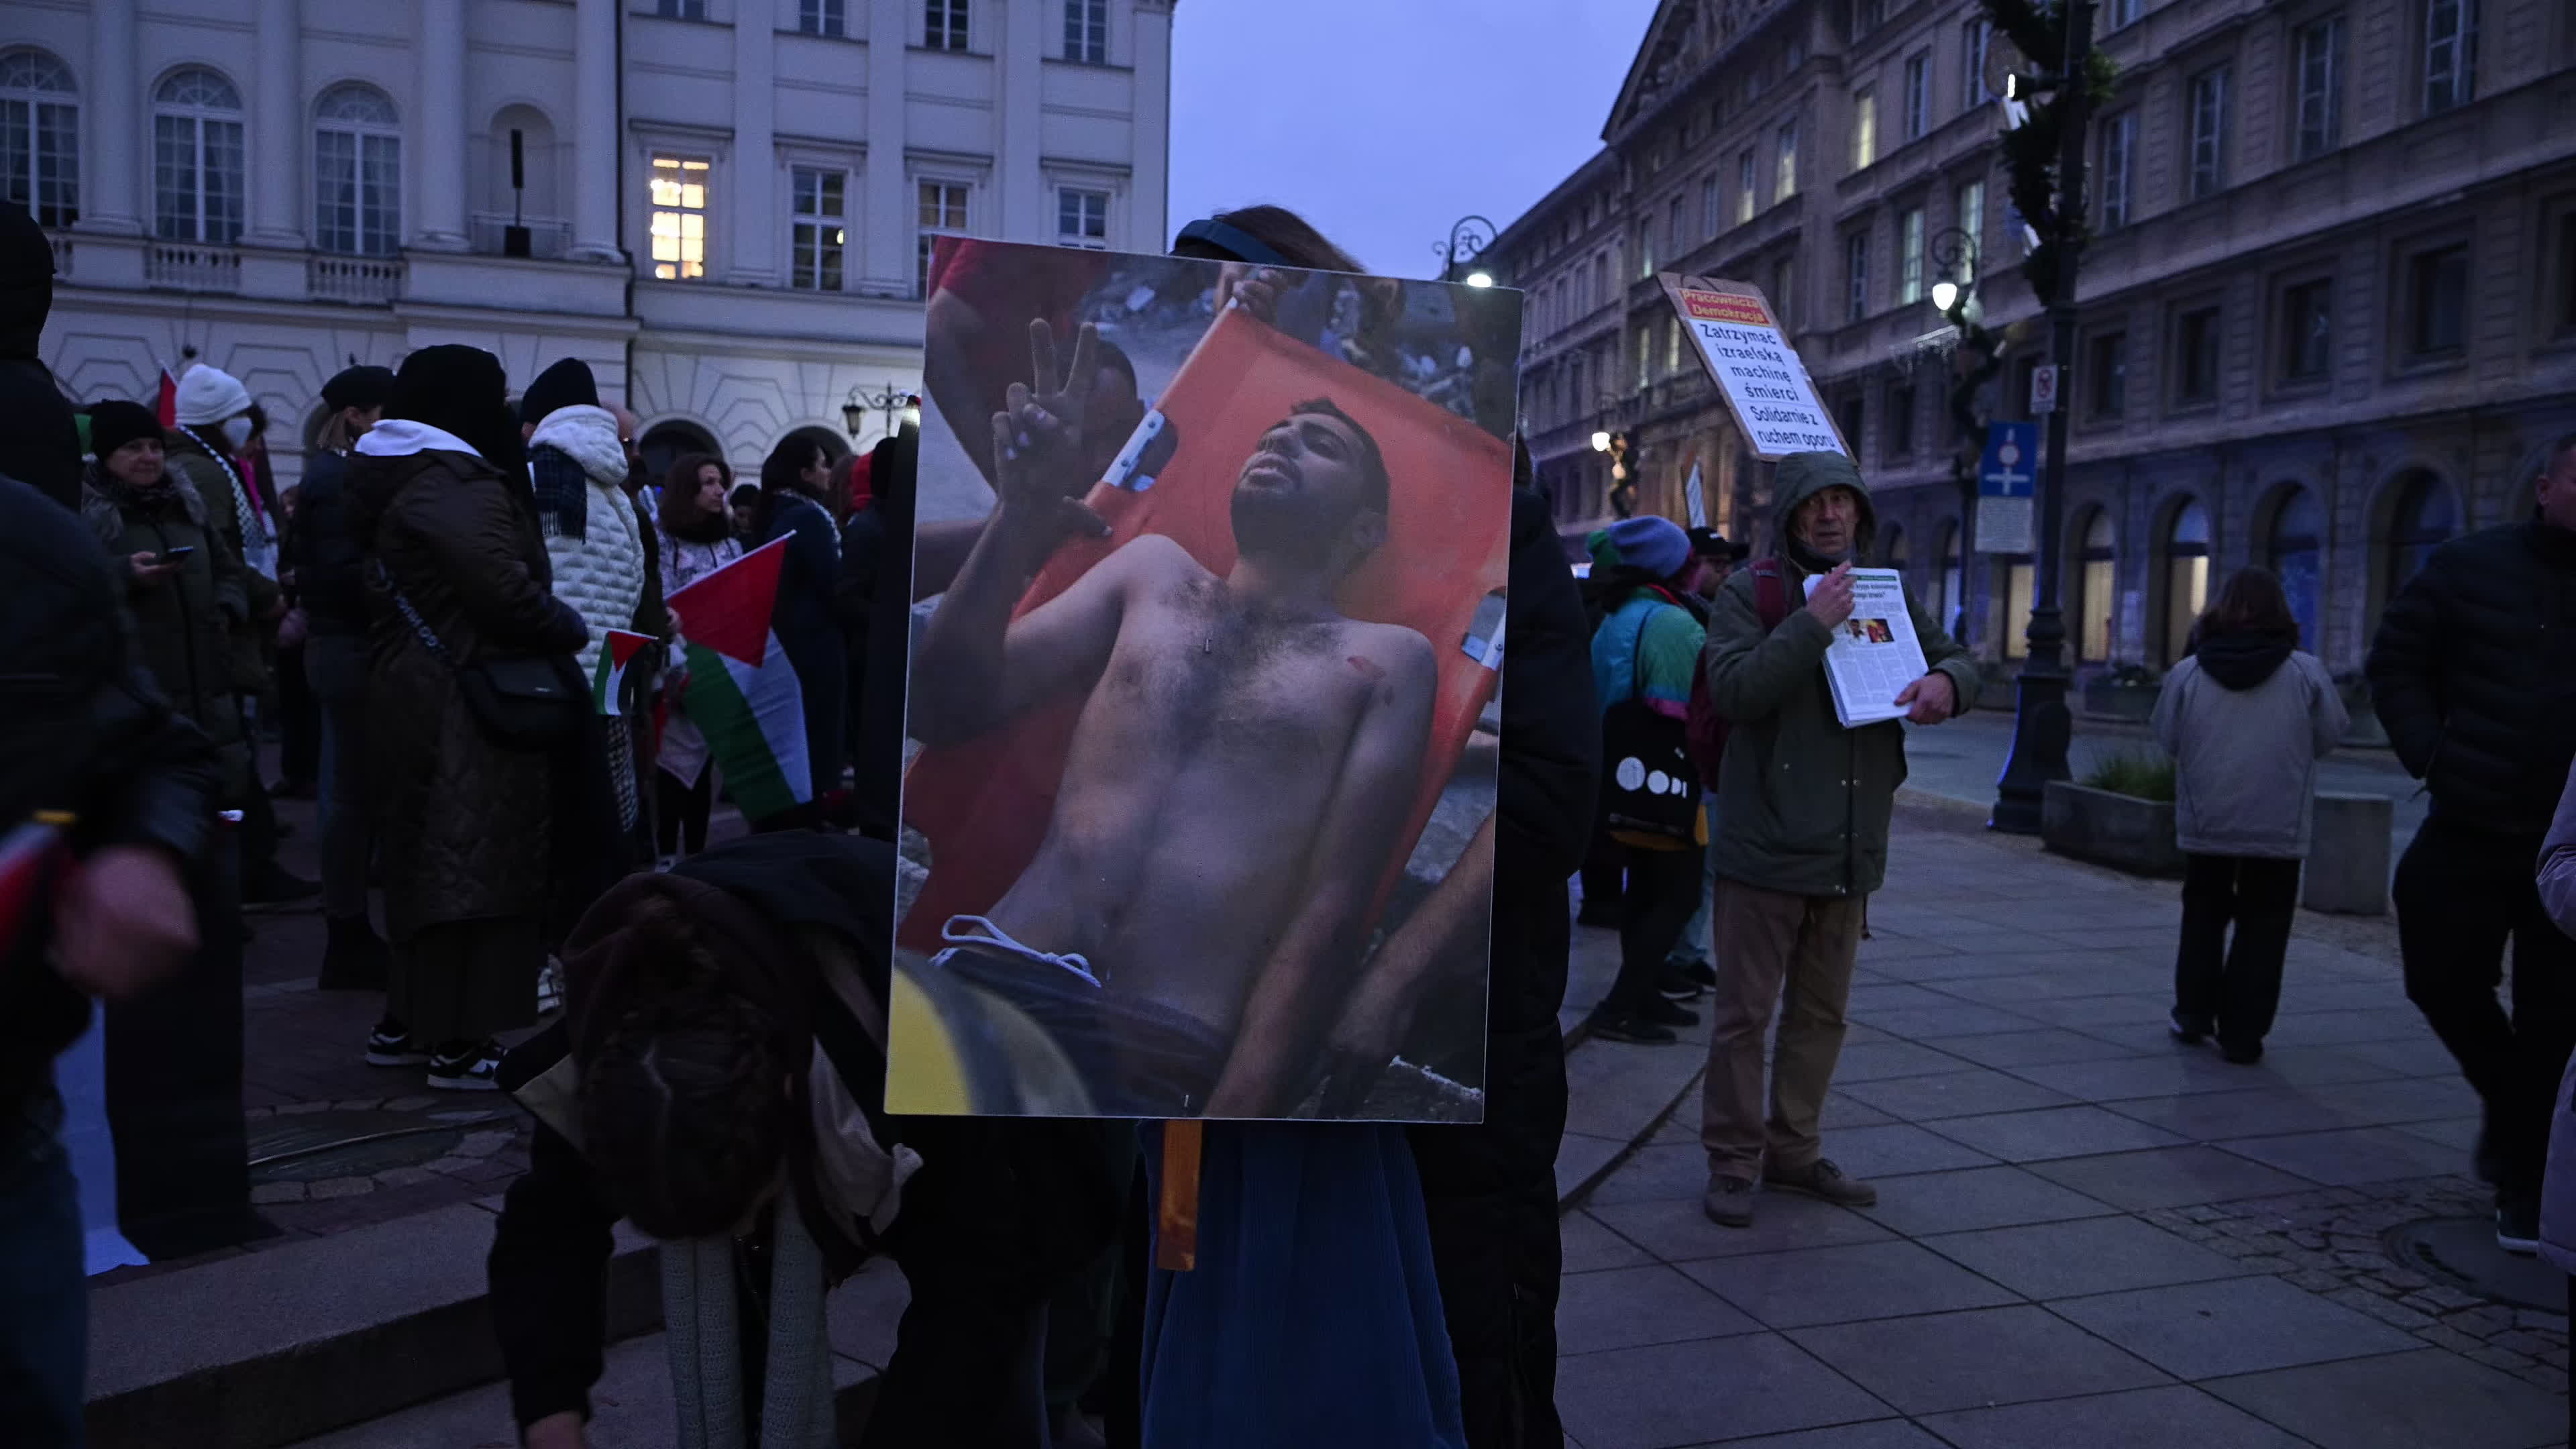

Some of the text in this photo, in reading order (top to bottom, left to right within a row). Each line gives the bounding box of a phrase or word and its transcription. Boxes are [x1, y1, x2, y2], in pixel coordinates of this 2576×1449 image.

[1699, 323, 1777, 344] Zatrzymać
[1715, 343, 1786, 366] izraelską
[1730, 364, 1792, 385] machinę
[1744, 382, 1800, 401] śmierci
[1750, 405, 1820, 425] Solidarnie z
[1758, 427, 1835, 451] ruchem oporu
